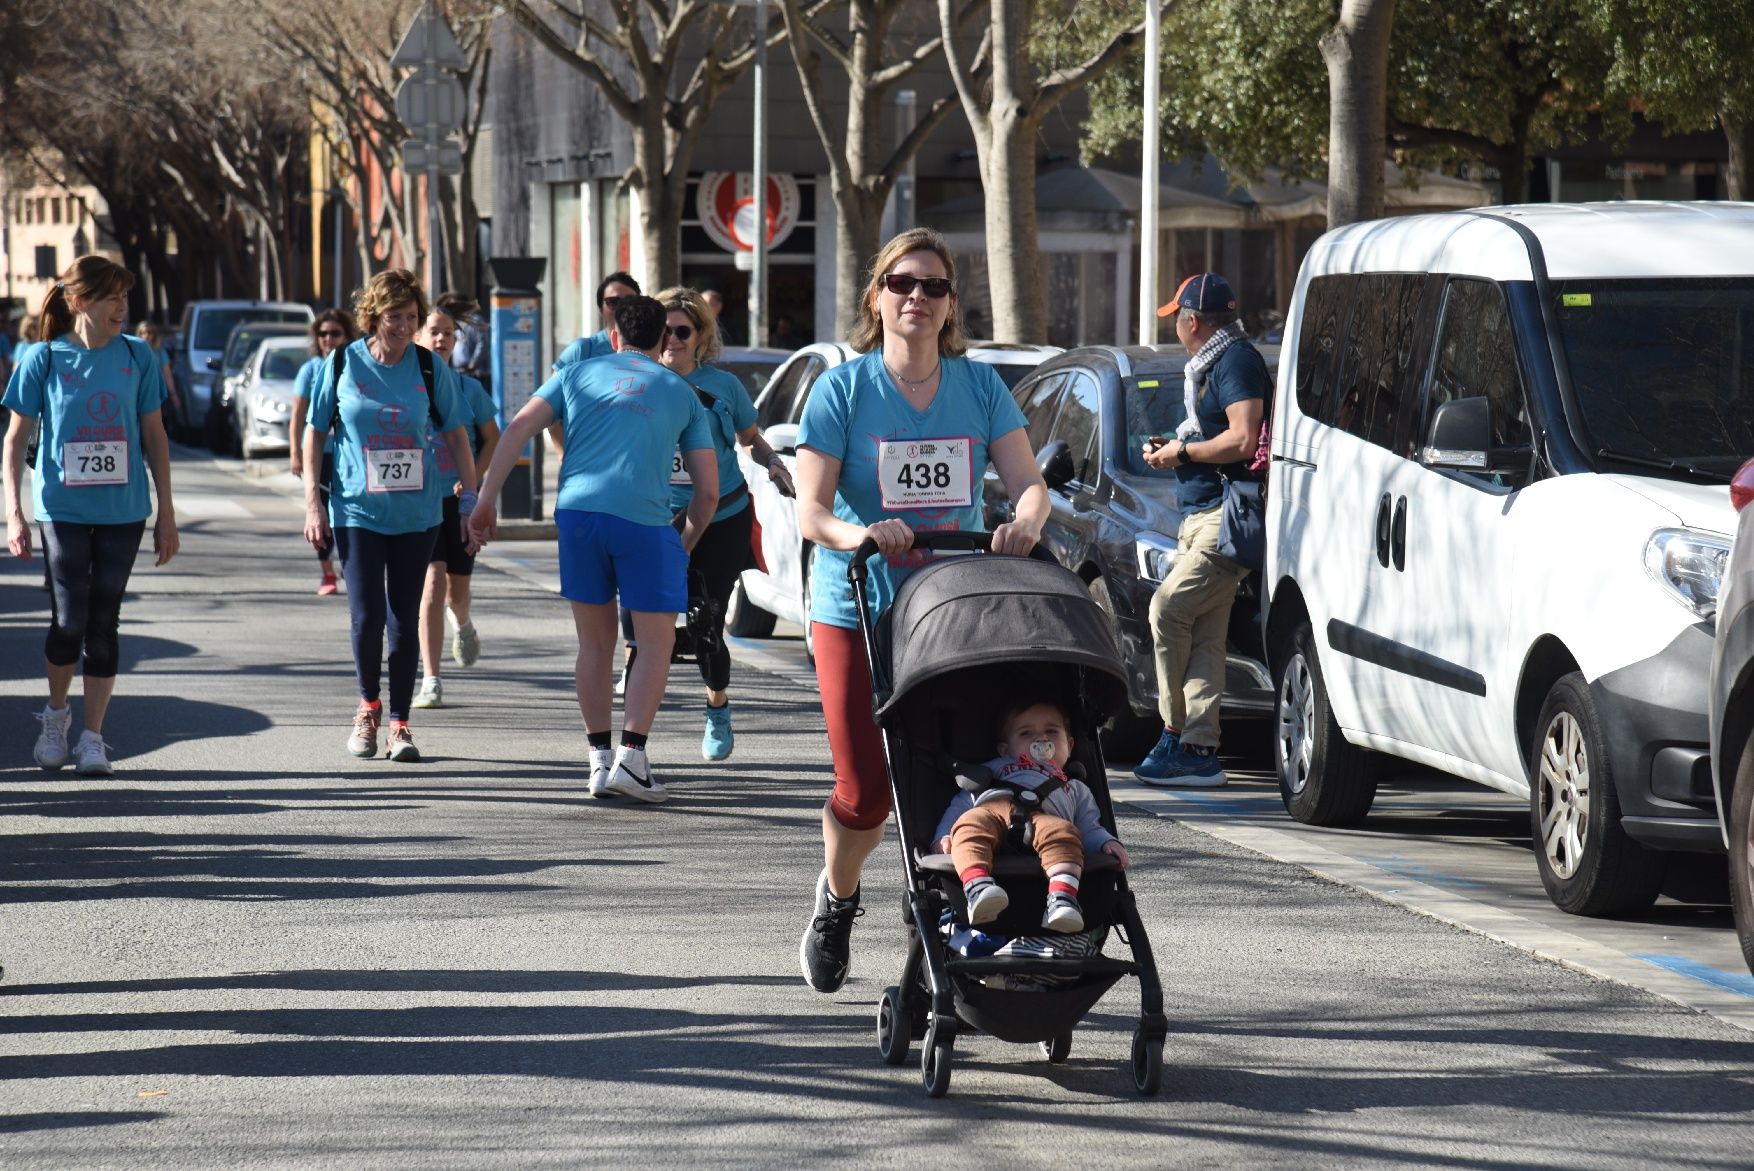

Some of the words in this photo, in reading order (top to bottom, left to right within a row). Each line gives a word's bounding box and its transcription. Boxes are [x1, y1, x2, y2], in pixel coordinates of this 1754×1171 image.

[78, 455, 116, 473] 738
[379, 463, 412, 480] 737
[897, 462, 951, 489] 438
